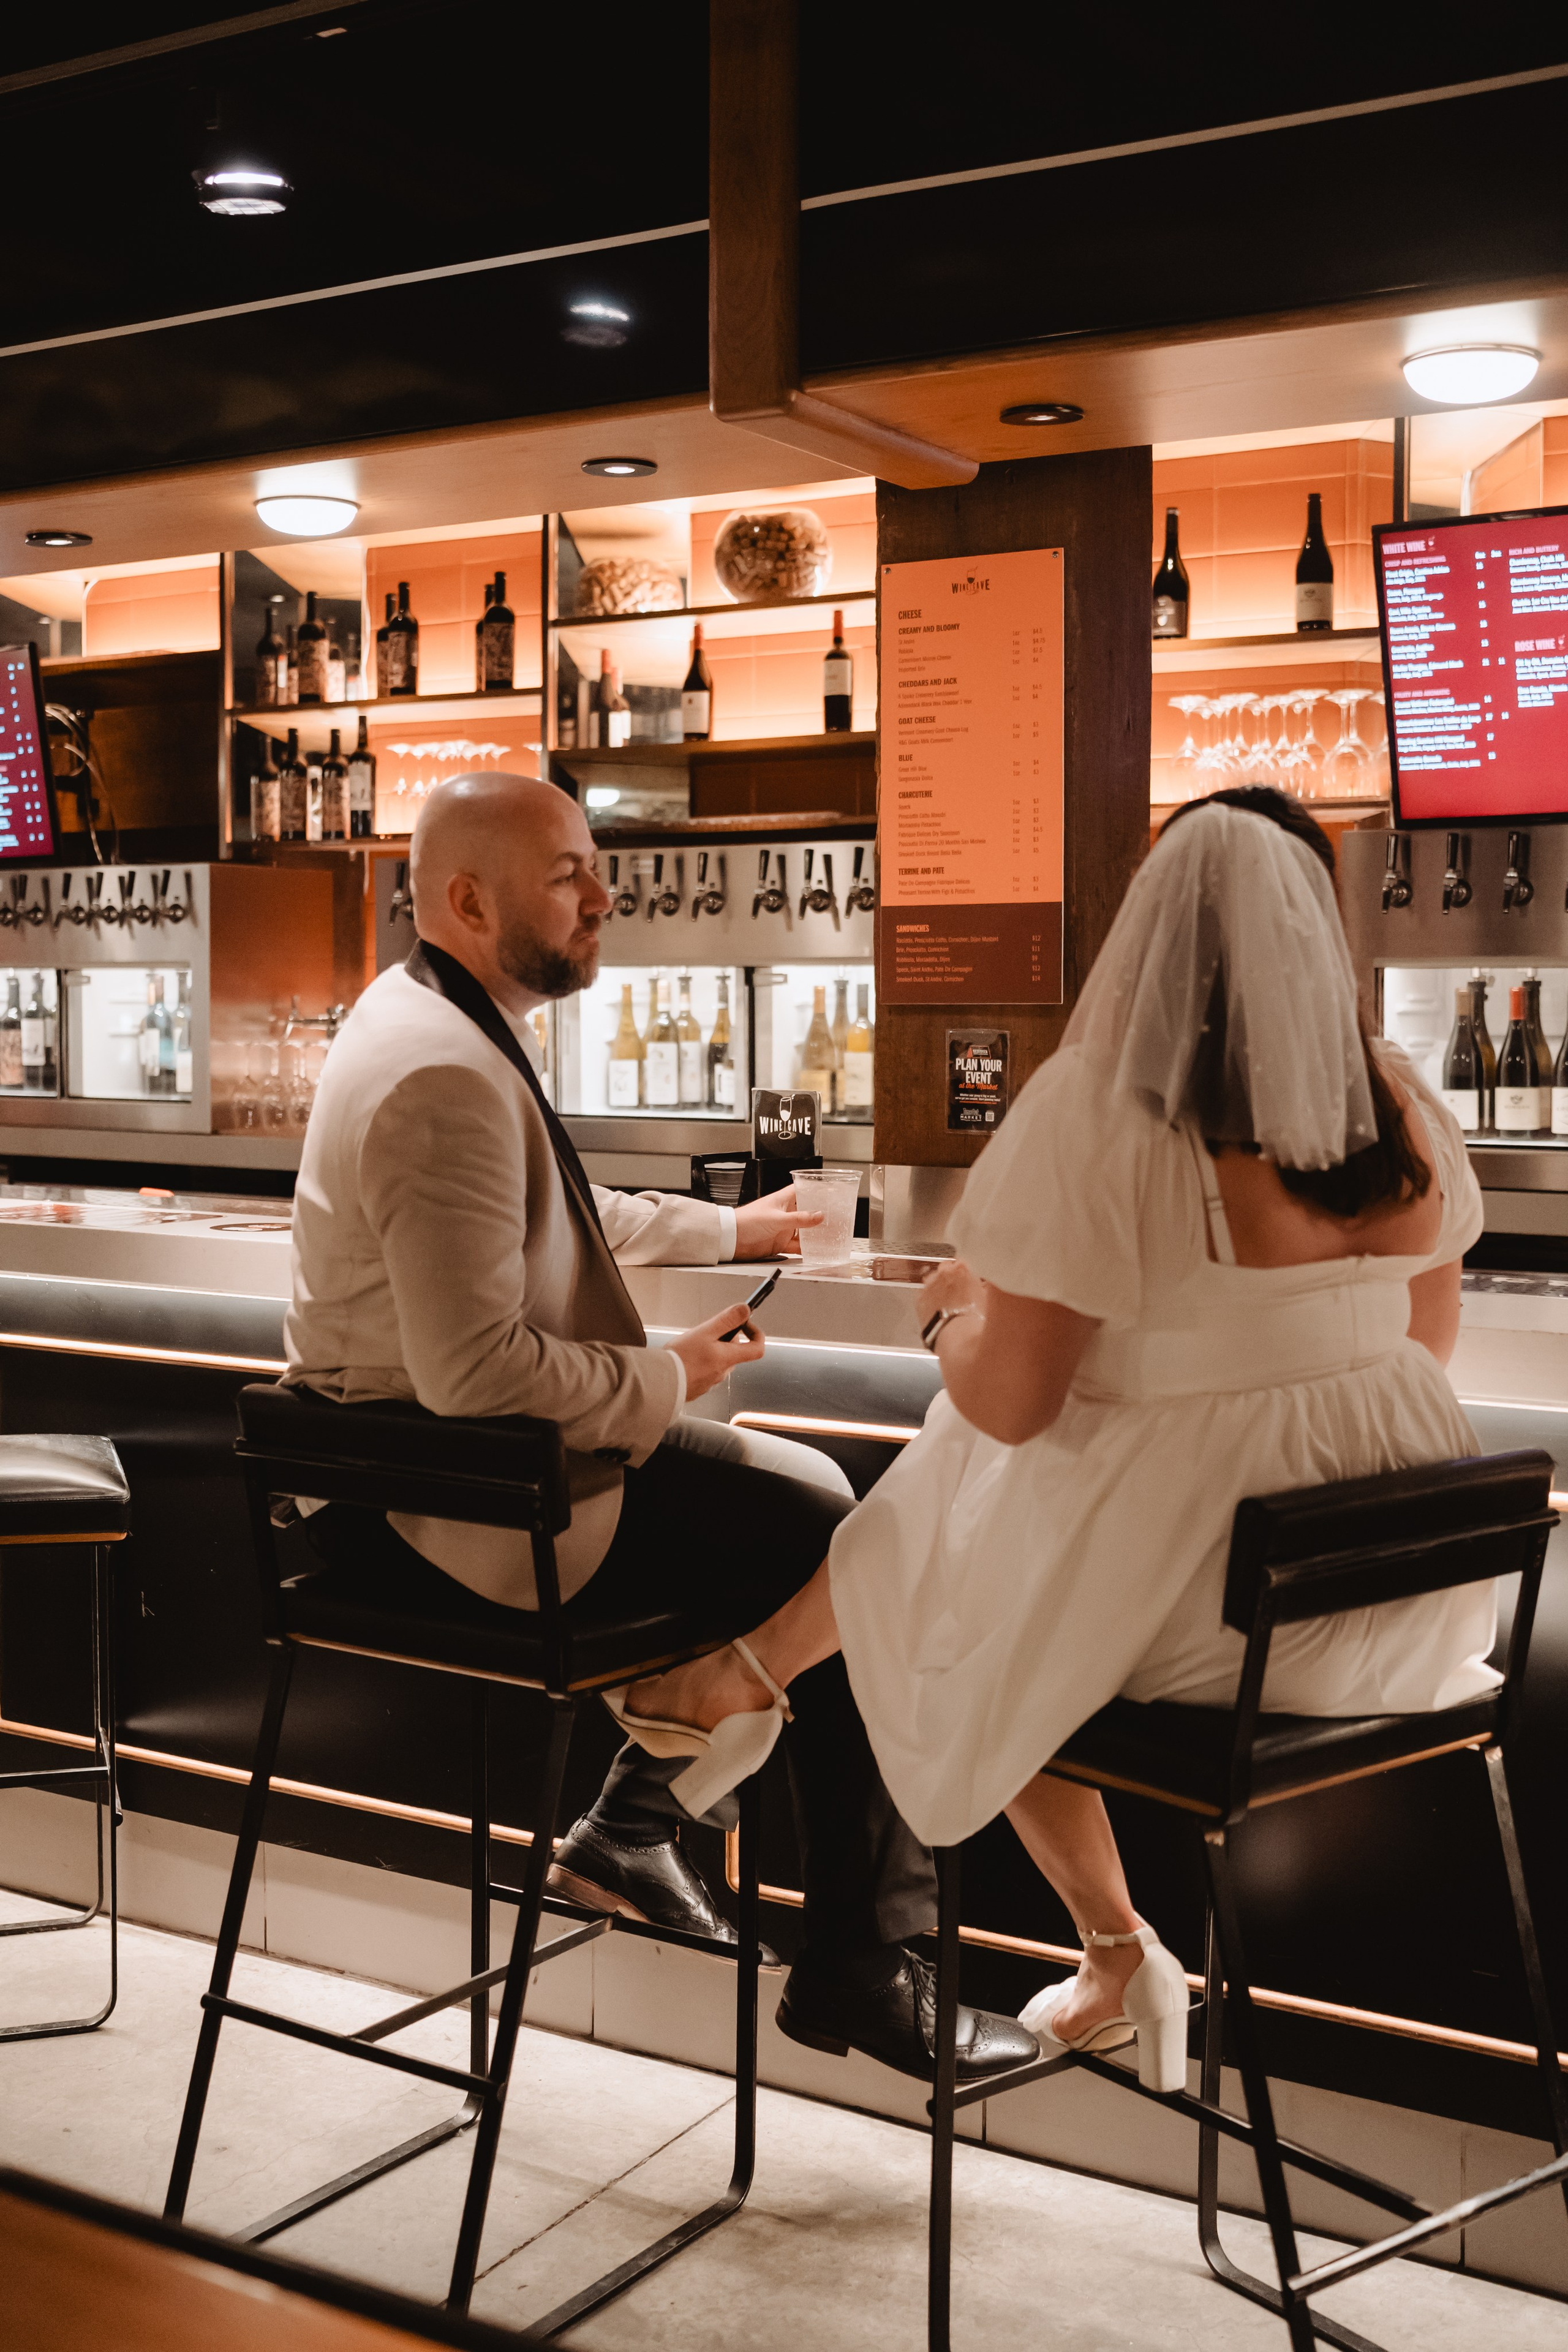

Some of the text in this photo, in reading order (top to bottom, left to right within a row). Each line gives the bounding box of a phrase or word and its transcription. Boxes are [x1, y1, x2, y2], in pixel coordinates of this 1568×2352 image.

[899, 609, 922, 619] CHEESE
[936, 623, 960, 631] BLOOMY
[899, 680, 929, 688] CHEDDARS
[899, 790, 933, 799] CHARCUTERIE
[956, 1058, 1003, 1072] PLAN YOUR
[966, 1071, 992, 1084] EVENT
[759, 1116, 812, 1135] WINE CAVE
